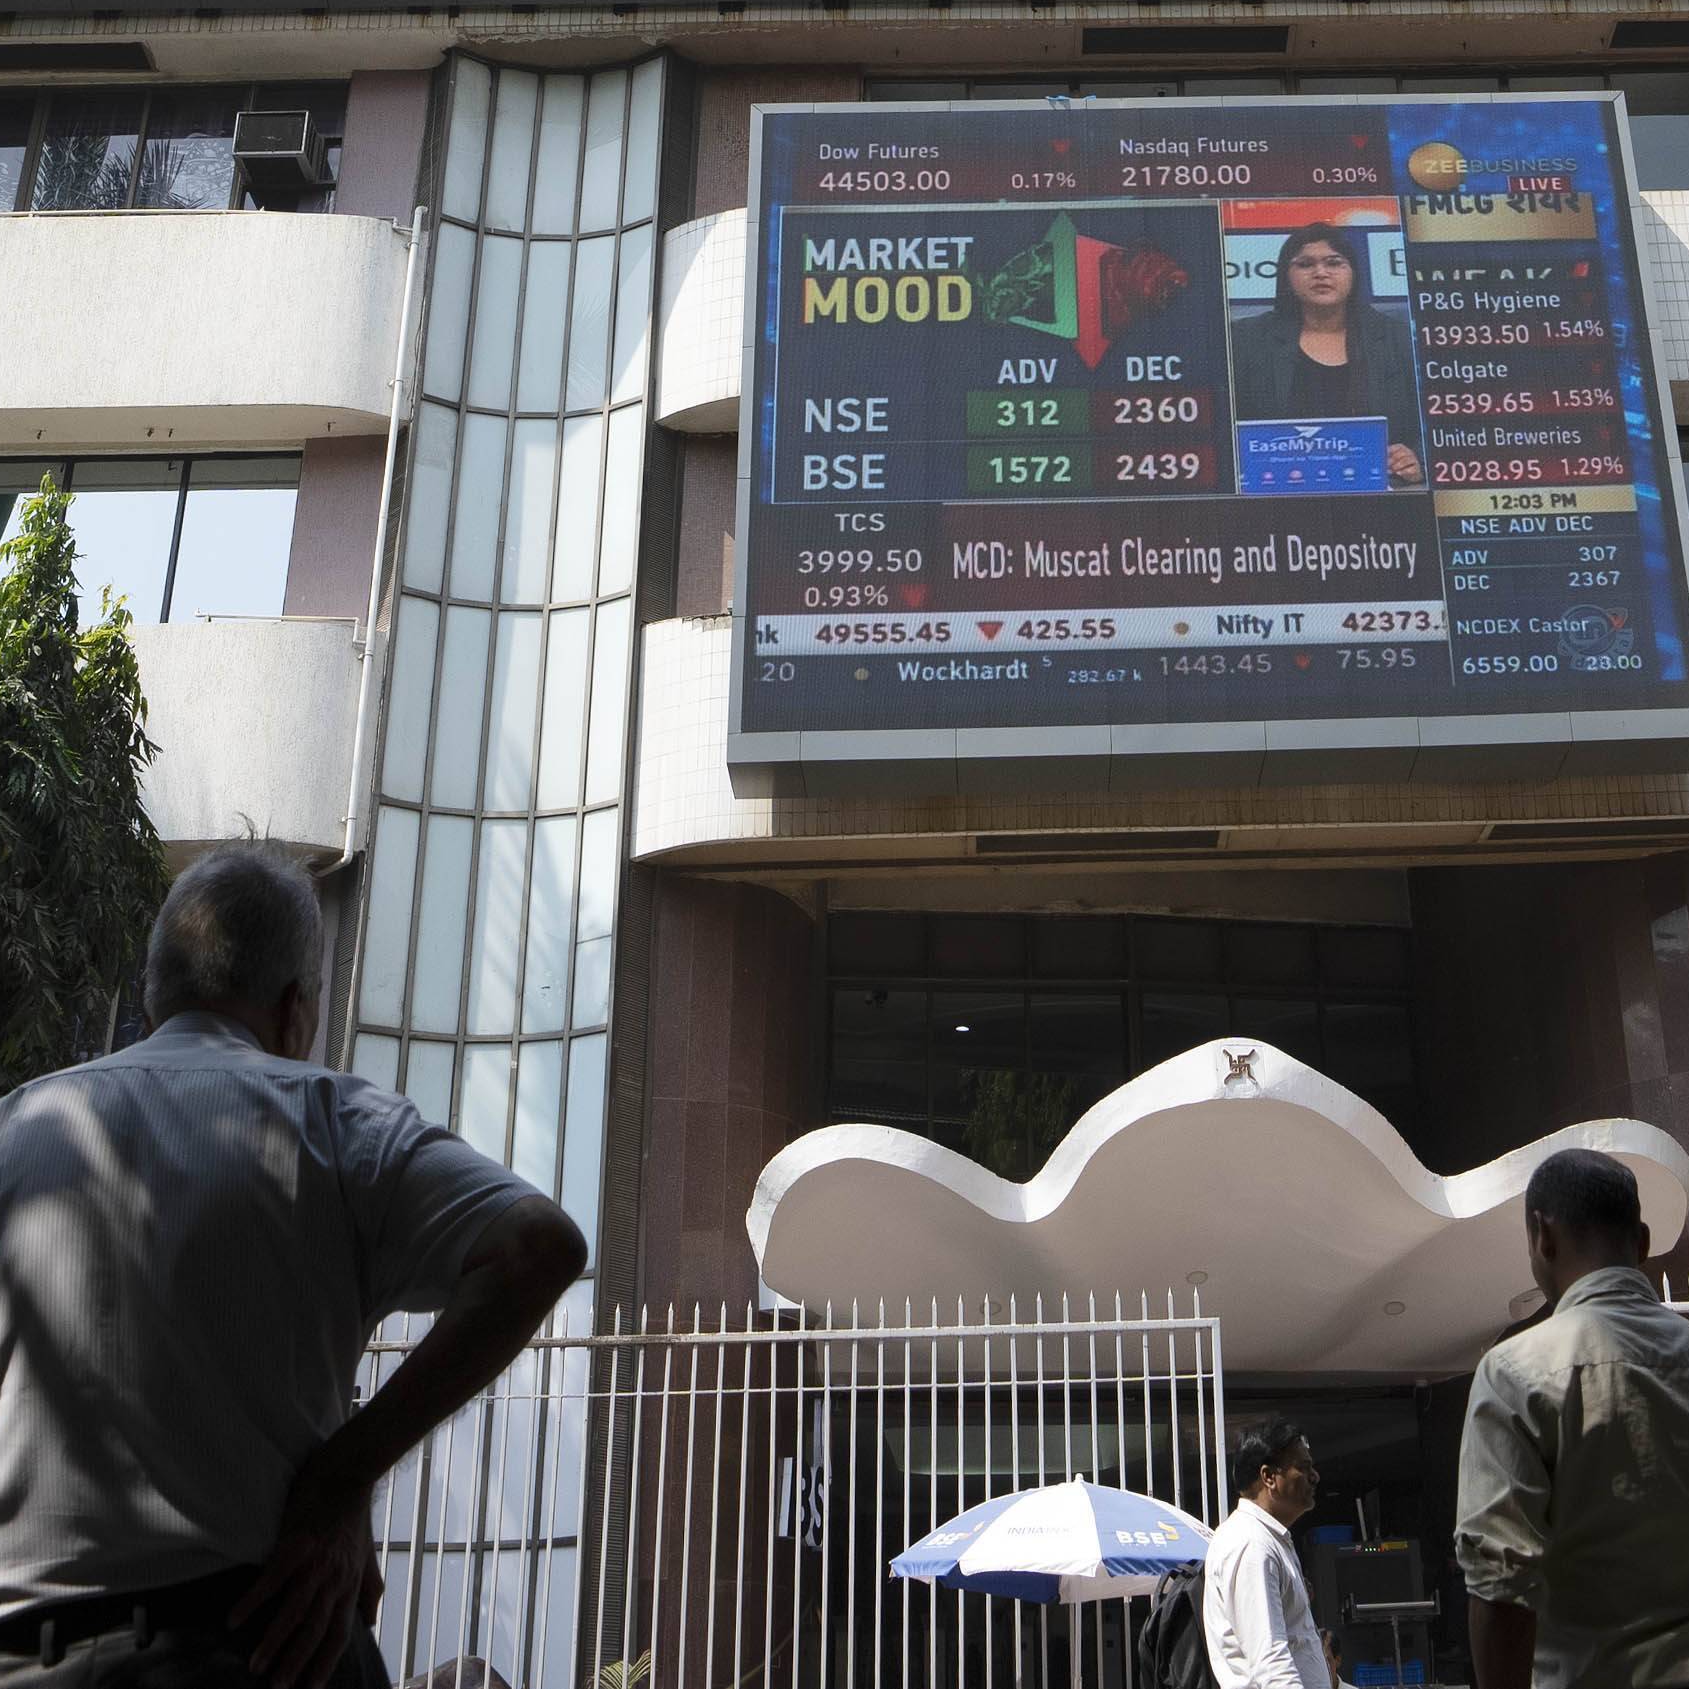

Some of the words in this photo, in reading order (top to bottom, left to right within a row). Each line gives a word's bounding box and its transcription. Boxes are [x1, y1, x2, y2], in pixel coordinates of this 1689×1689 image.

[818, 143, 860, 160] Dow
[868, 142, 939, 159] Futures
[1119, 137, 1190, 158] Nasdaq
[1197, 136, 1269, 154] Futures
[819, 169, 951, 192] 44503.00
[1011, 172, 1077, 190] 0.17%
[1121, 164, 1251, 189] 21780.00
[1312, 166, 1377, 185] 0.30%
[1518, 176, 1563, 192] LIVE
[803, 236, 973, 271] MARKET
[803, 275, 973, 324] MOOD
[1418, 291, 1465, 311] P&G
[1475, 290, 1561, 314] Hygiene
[1421, 324, 1530, 346] 13933.50
[1542, 320, 1604, 339] 1.54%
[997, 358, 1058, 384] ADV
[1126, 355, 1183, 382] DEC
[1426, 359, 1509, 383] Colgate
[1427, 391, 1534, 416] 2539.65
[1551, 389, 1614, 409] 1.53%
[804, 397, 889, 433] NSE
[996, 400, 1060, 427] 312
[1113, 397, 1199, 424] 2360
[1432, 427, 1488, 448] United
[1494, 425, 1582, 447] Breweries
[802, 454, 886, 490] BSE
[989, 456, 1072, 484] 1572
[1116, 453, 1200, 481] 2439
[1435, 459, 1543, 483] 2028.95
[1560, 456, 1624, 477] 1.29%
[1489, 492, 1543, 510] 12:03
[1550, 492, 1578, 508] PM
[834, 512, 886, 533] TCS
[1461, 518, 1500, 535] NSE
[1508, 516, 1547, 534] ADV
[1555, 515, 1593, 533] DEC
[798, 549, 923, 574] 3999.50
[952, 541, 1014, 580] MCD:
[1024, 540, 1111, 578] Muscat
[1120, 536, 1221, 583] Clearing
[1233, 534, 1277, 574] and
[1286, 533, 1418, 580] Depository
[1451, 548, 1488, 566] ADV
[1578, 545, 1618, 562] 307
[1454, 573, 1490, 591] DEC
[1568, 570, 1621, 588] 2367
[804, 584, 889, 608] 0.93%
[814, 621, 952, 644] 49555.45
[1016, 618, 1116, 641] 425.55
[1216, 612, 1273, 639] Nifty
[1284, 612, 1305, 634] IT
[1456, 618, 1521, 635] NCDEX
[1528, 617, 1590, 633] Castor
[897, 658, 1030, 682] Wockhardt
[1159, 653, 1273, 678] 1443.45
[1336, 647, 1417, 670] 75.95
[1462, 654, 1559, 675] 6559.00
[1115, 1529, 1167, 1546] BSE
